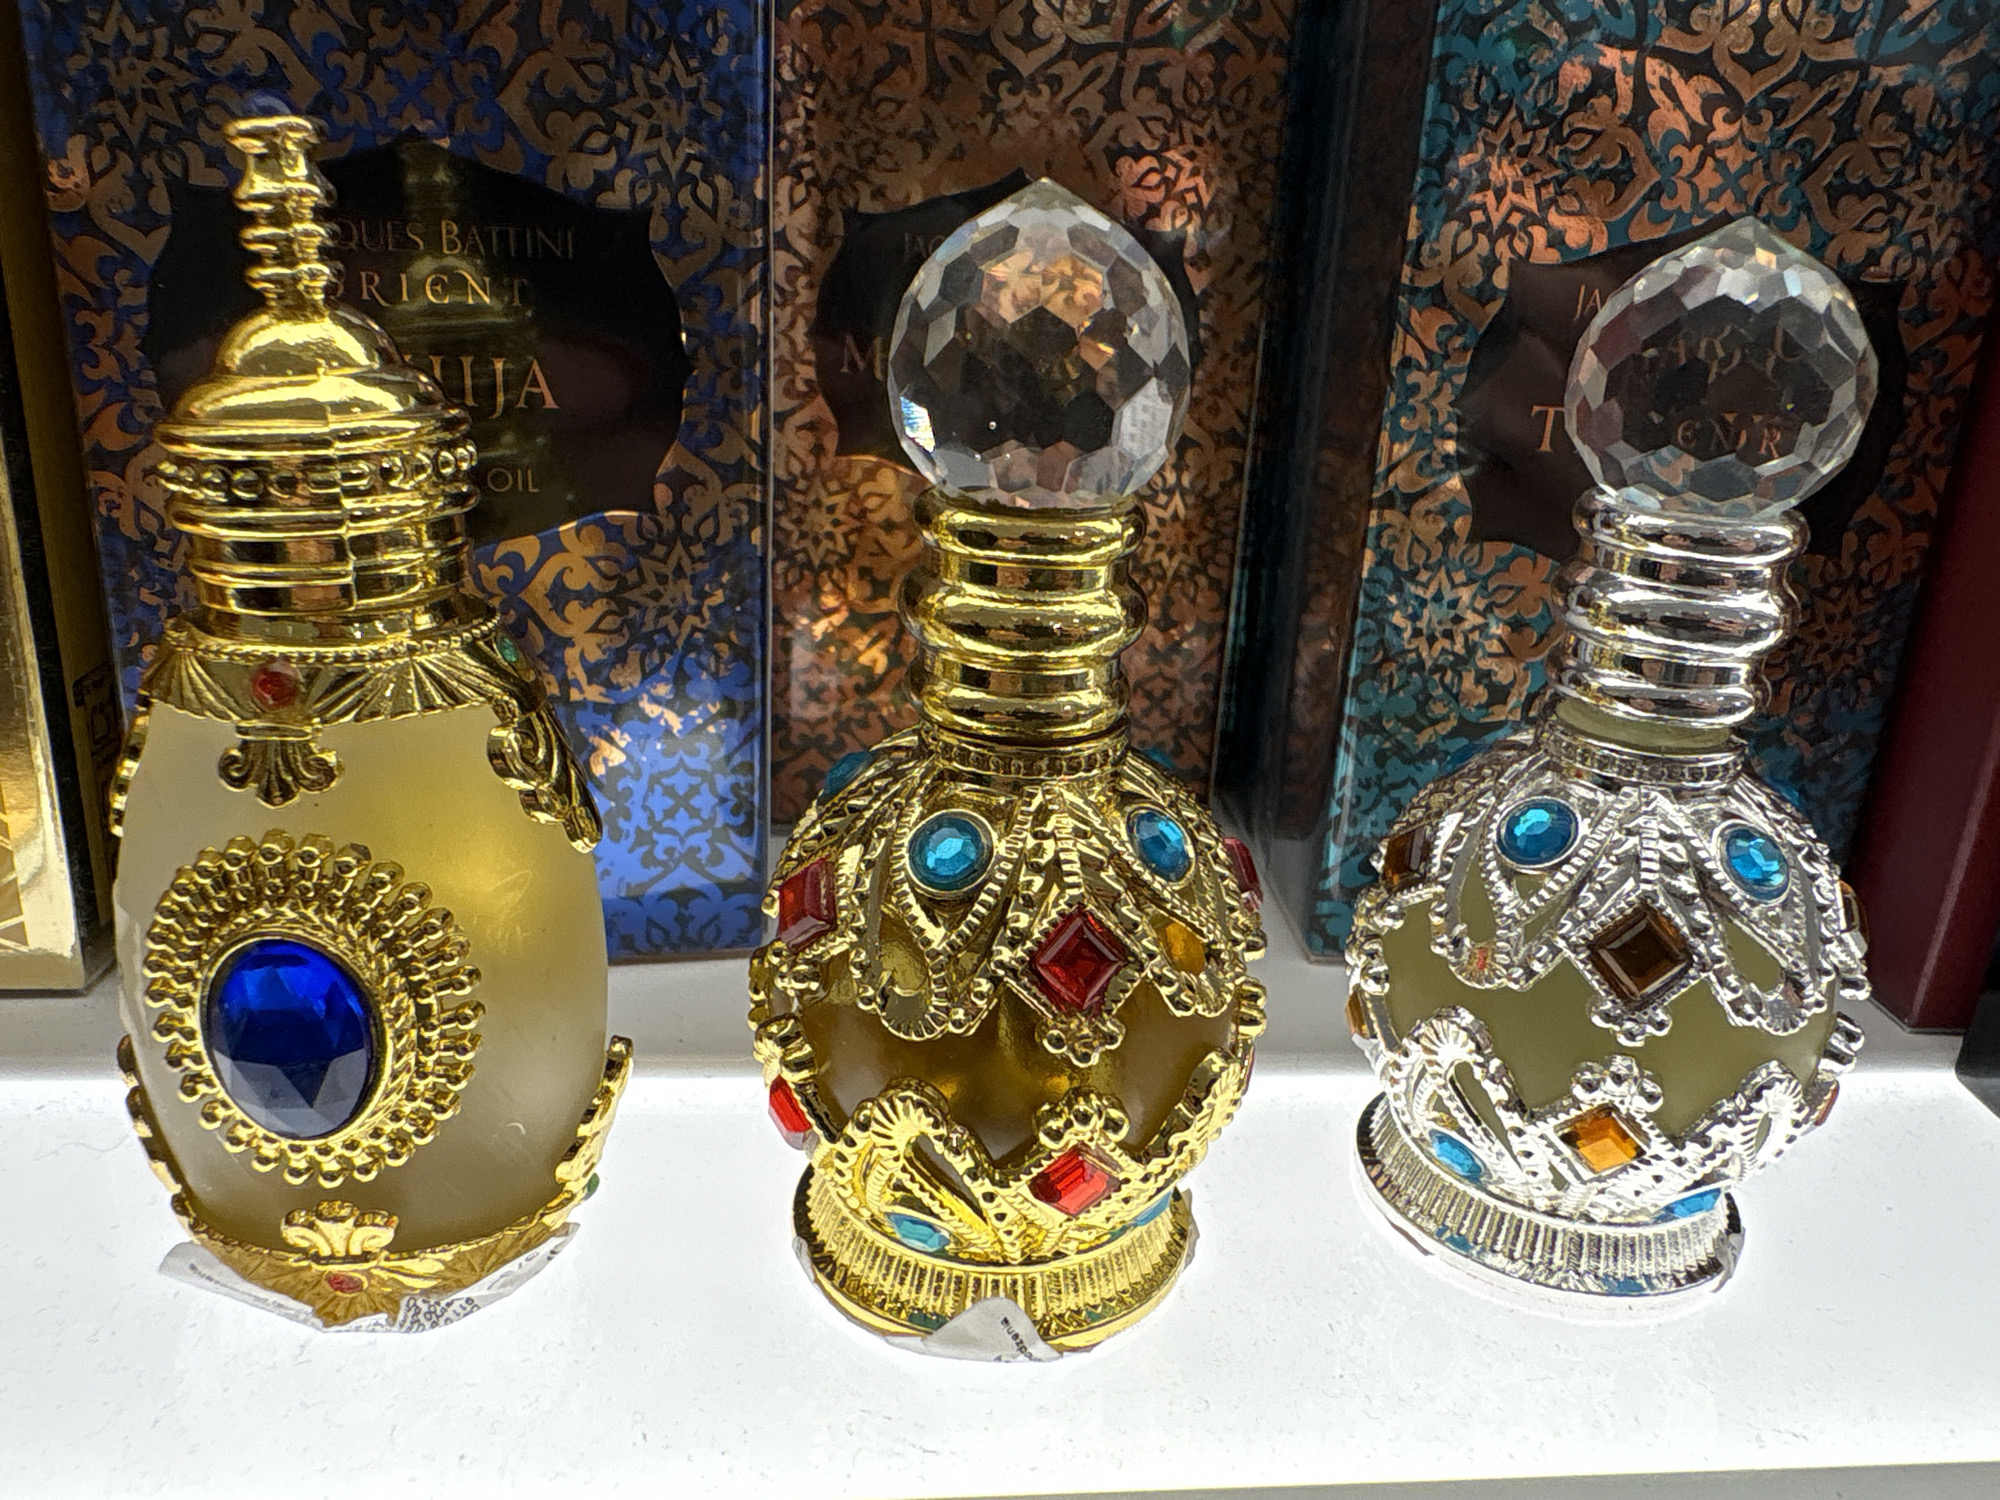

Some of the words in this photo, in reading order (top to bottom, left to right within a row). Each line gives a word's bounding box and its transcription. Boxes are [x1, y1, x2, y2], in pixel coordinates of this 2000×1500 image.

[336, 216, 425, 251] QUES
[440, 218, 576, 260] BATTINI
[486, 467, 540, 494] OIL
